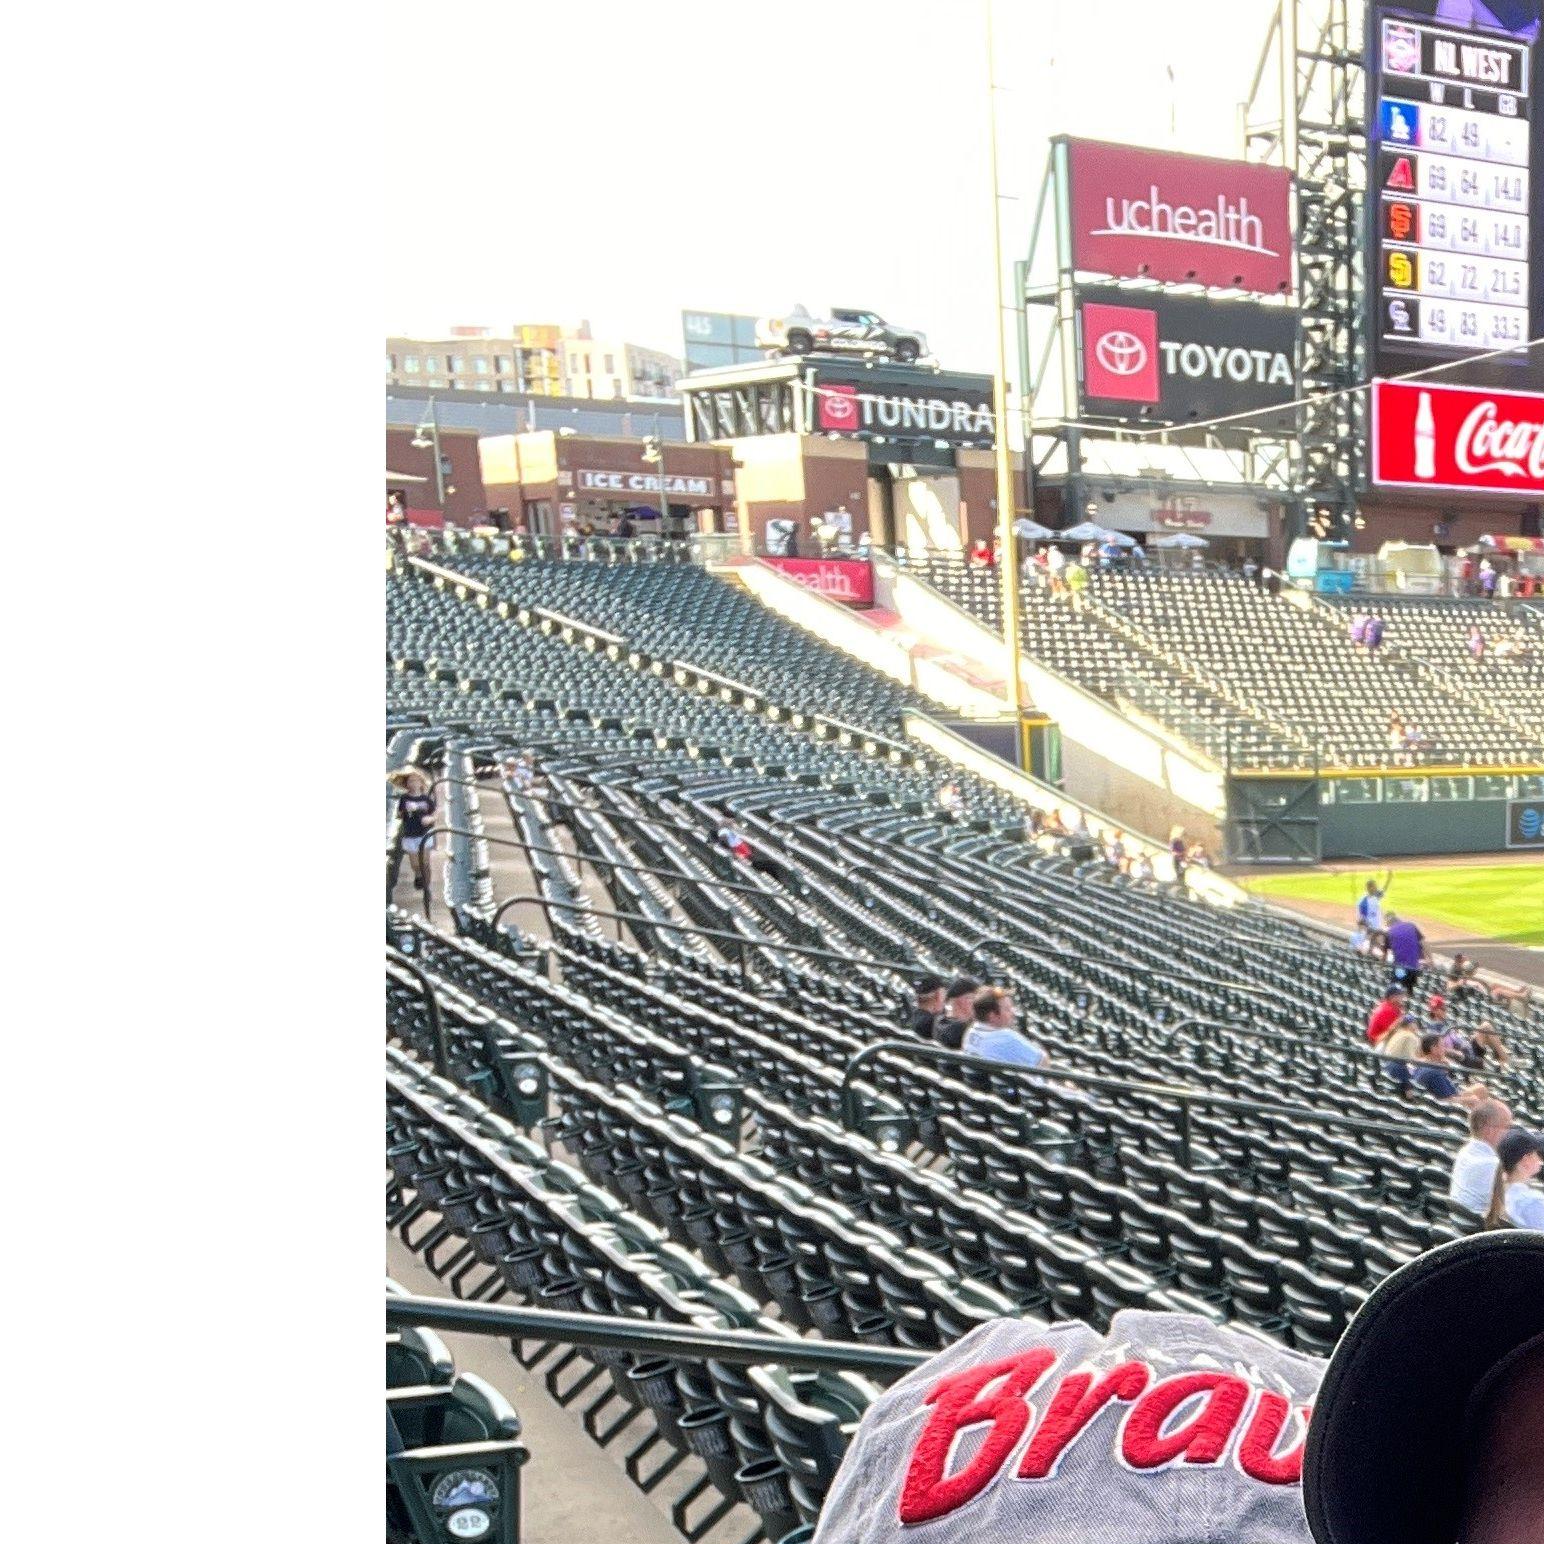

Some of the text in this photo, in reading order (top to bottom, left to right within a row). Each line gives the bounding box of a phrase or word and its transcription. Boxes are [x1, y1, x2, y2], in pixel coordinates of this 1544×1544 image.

[1435, 40, 1512, 84] NL WEST
[1106, 185, 1262, 249] uchealth
[1160, 341, 1294, 385] TOYOTA
[858, 393, 996, 433] TUNDRA
[584, 473, 708, 494] ICE CREAM
